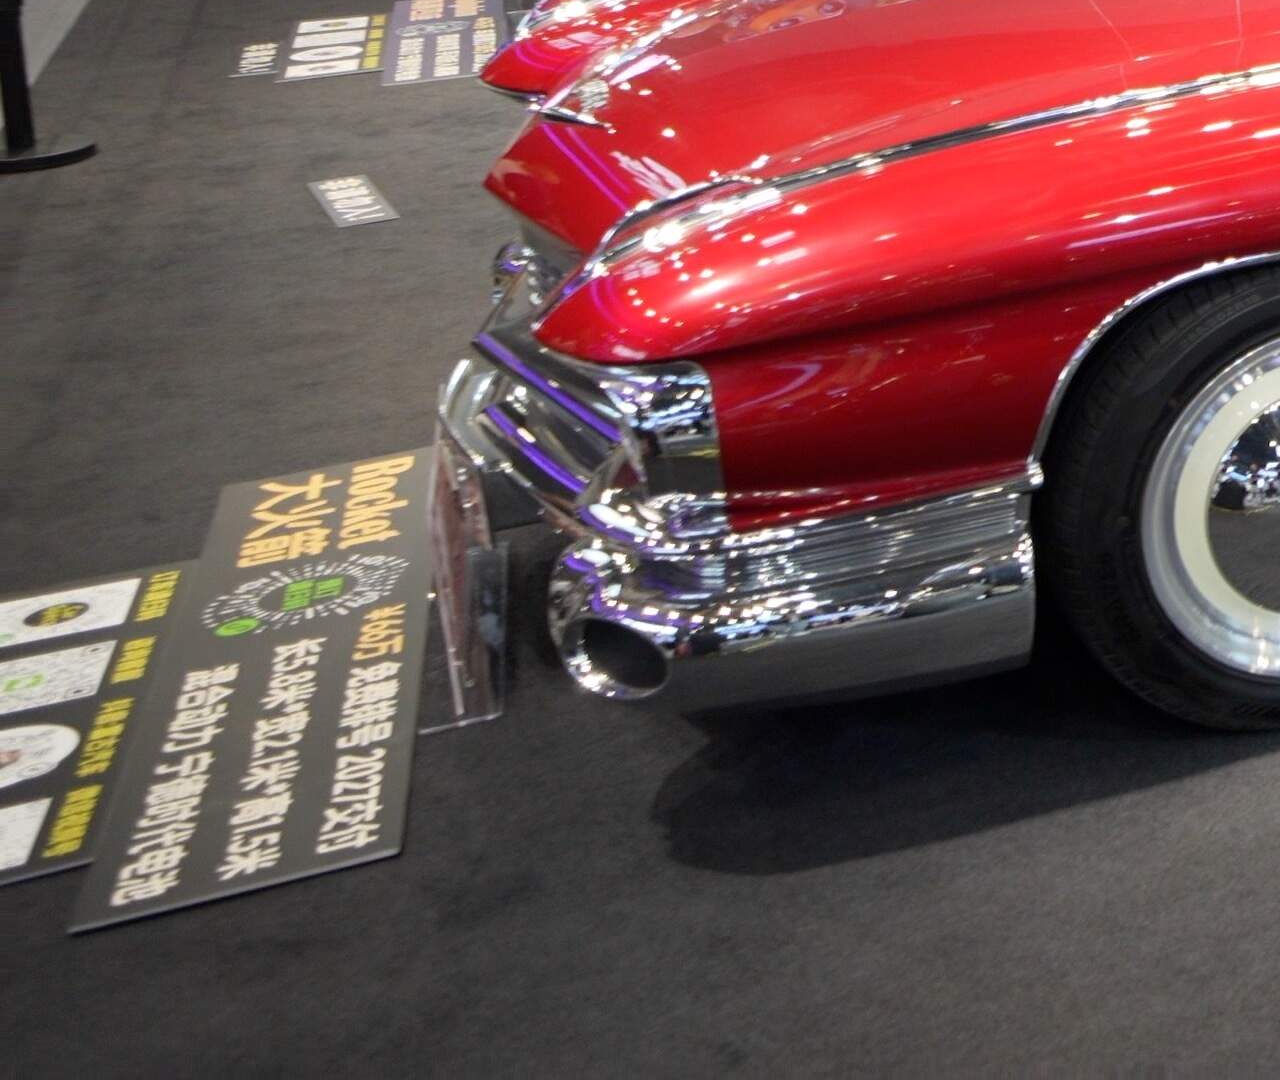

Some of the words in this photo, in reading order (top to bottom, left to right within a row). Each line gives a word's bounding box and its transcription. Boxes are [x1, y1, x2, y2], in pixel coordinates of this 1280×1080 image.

[236, 473, 342, 568] 大火箭
[338, 455, 415, 550] Rocket
[353, 602, 408, 661] ¥66万
[163, 662, 240, 755] 混合动力
[335, 660, 404, 750] 免费排号
[109, 753, 218, 909] 宁德时代电池
[315, 748, 388, 855] 2027交付
